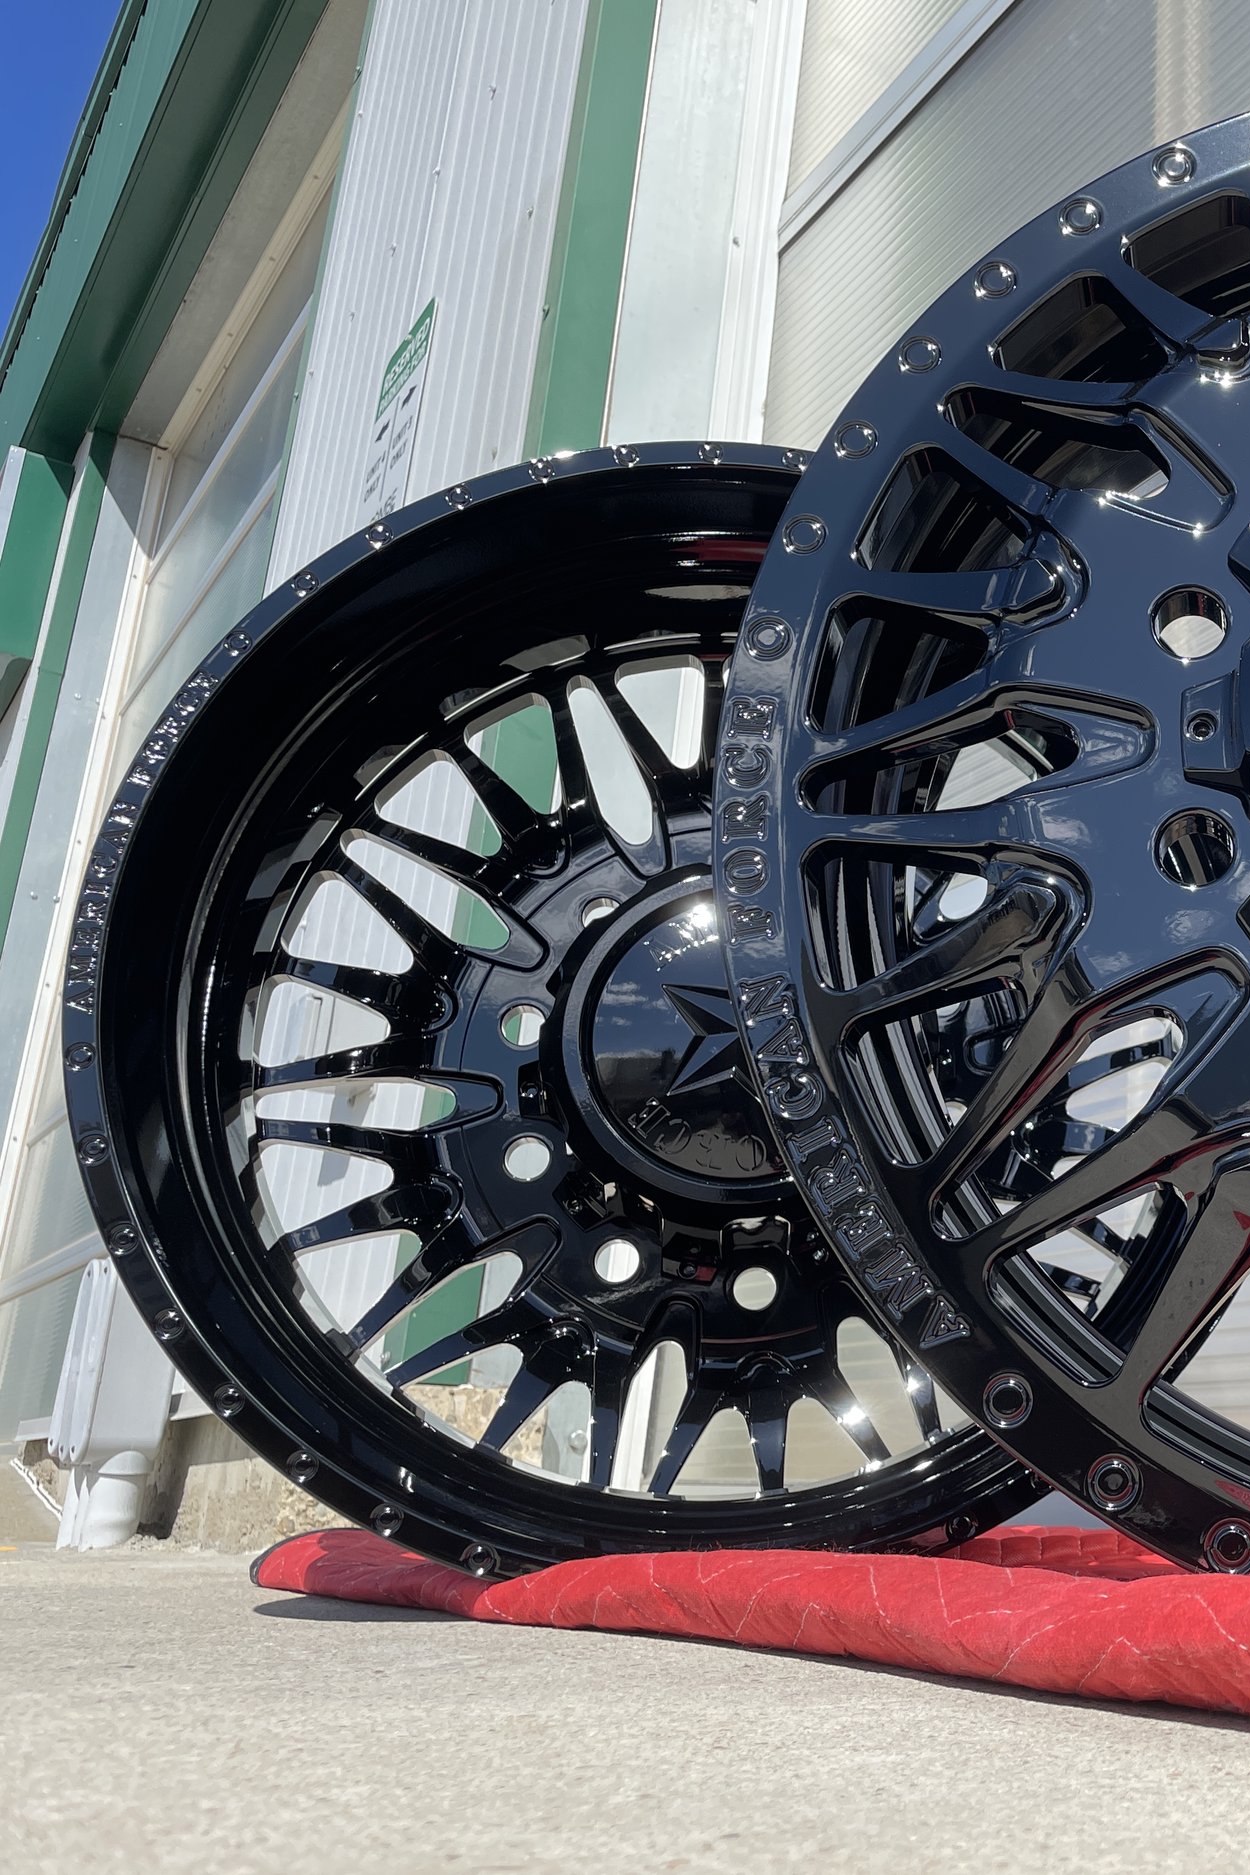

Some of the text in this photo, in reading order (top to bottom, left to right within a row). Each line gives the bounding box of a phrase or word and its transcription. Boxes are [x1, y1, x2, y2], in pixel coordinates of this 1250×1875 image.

[382, 315, 431, 398] RESERVED
[364, 472, 381, 503] ONLY
[390, 439, 407, 470] ONLY
[65, 671, 220, 1015] AMERICAN FORCE
[720, 696, 973, 1350] AMERICAN FORCE
[627, 1096, 767, 1172] ORCE
